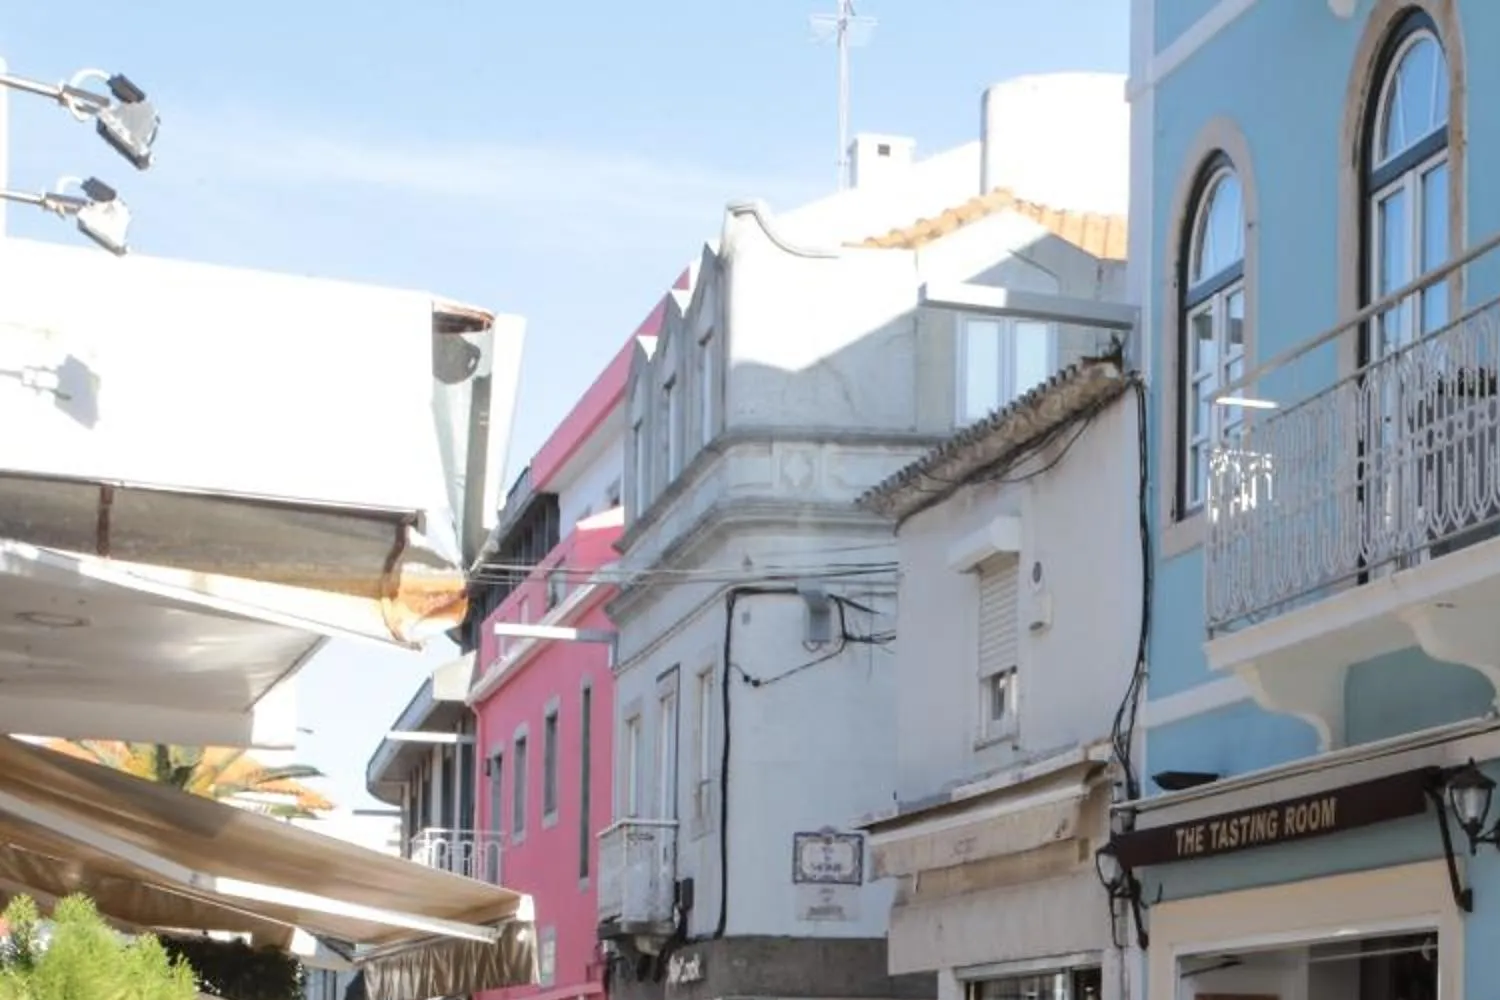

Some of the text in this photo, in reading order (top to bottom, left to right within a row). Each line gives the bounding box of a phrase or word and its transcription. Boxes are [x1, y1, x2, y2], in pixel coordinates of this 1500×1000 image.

[1176, 797, 1337, 857] THE TASTING ROOM
